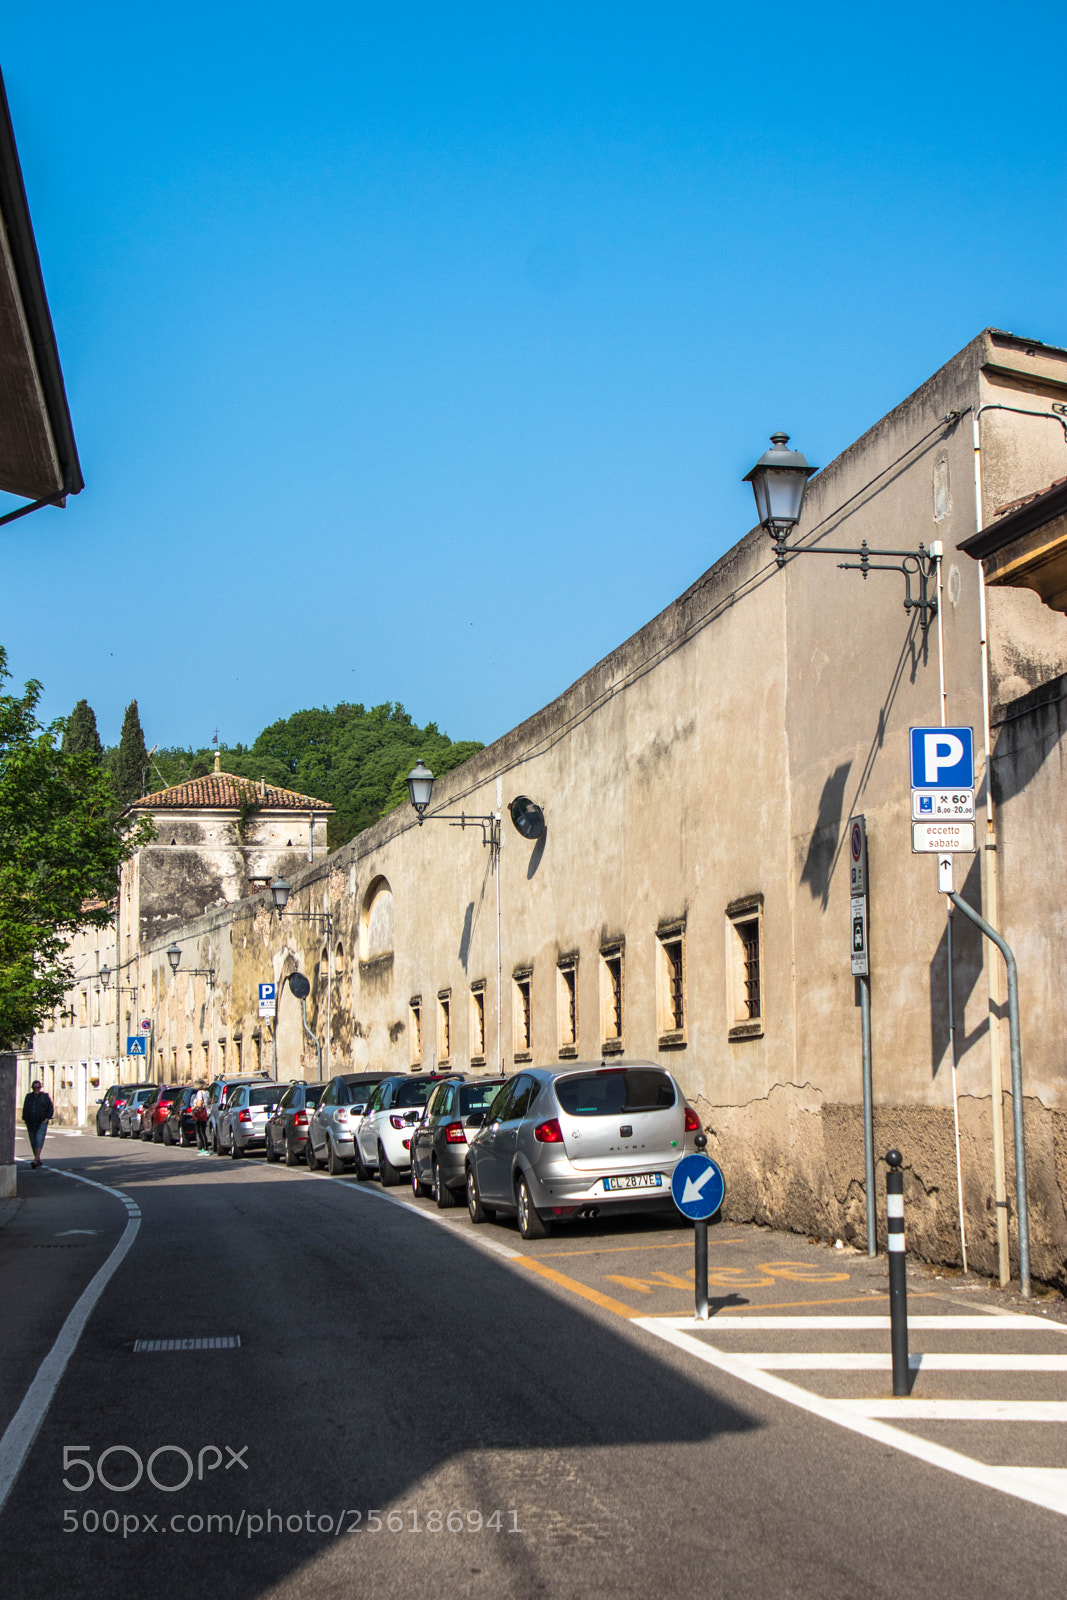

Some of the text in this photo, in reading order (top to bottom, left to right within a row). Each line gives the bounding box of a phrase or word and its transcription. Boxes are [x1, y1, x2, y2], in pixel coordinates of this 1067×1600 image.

[924, 733, 964, 783] P
[926, 826, 960, 835] eccetto
[928, 838, 960, 848] sabato
[262, 984, 273, 999] P
